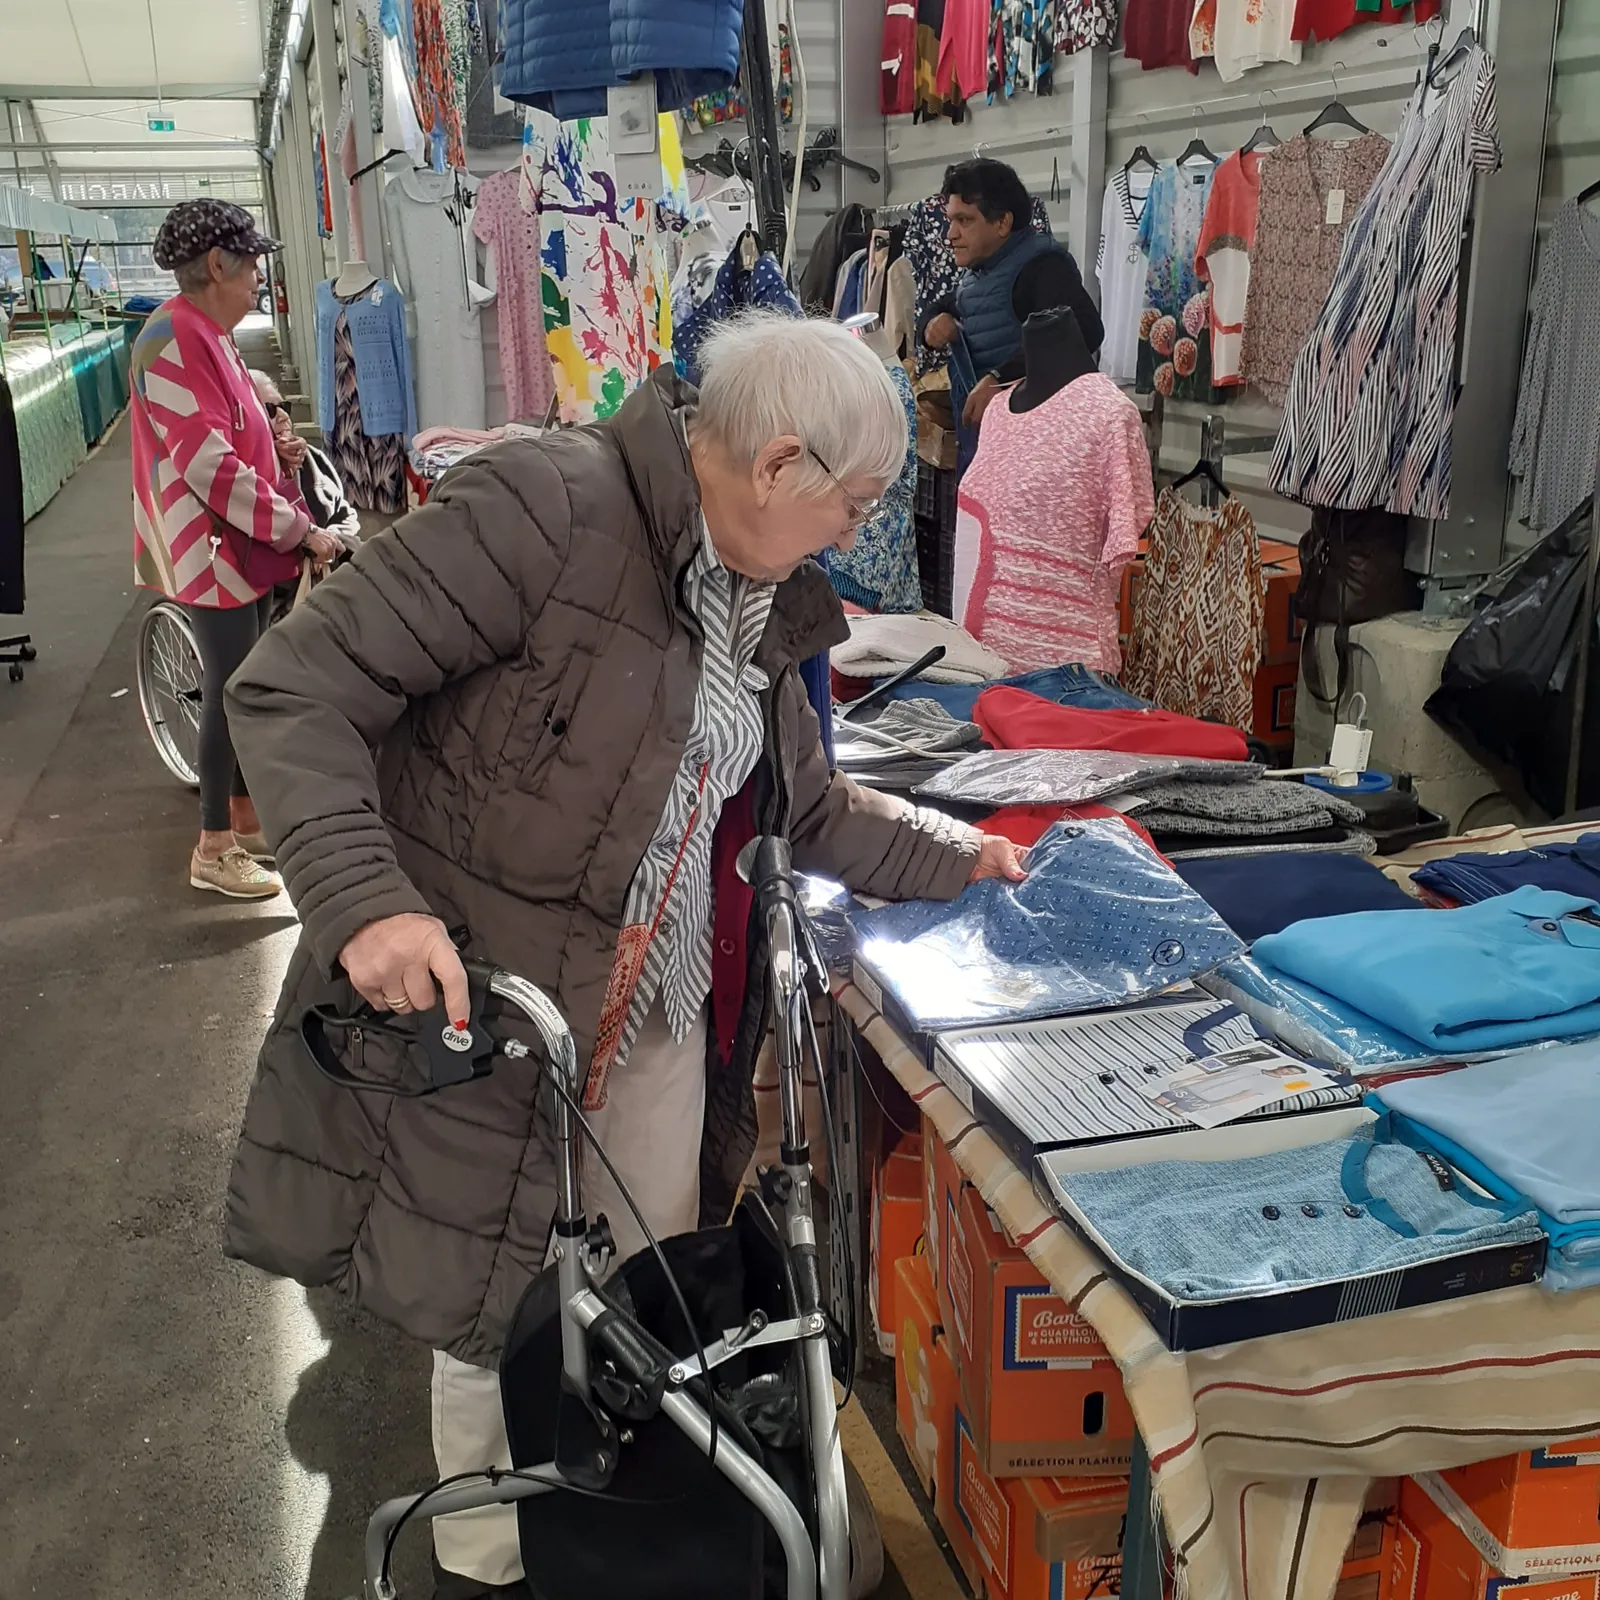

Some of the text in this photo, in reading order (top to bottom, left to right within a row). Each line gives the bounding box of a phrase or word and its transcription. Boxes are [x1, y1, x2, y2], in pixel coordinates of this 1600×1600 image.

[443, 1031, 469, 1047] drive
[1009, 1455, 1075, 1468] SÉLECTION
[1525, 1554, 1593, 1568] SÉLECTION
